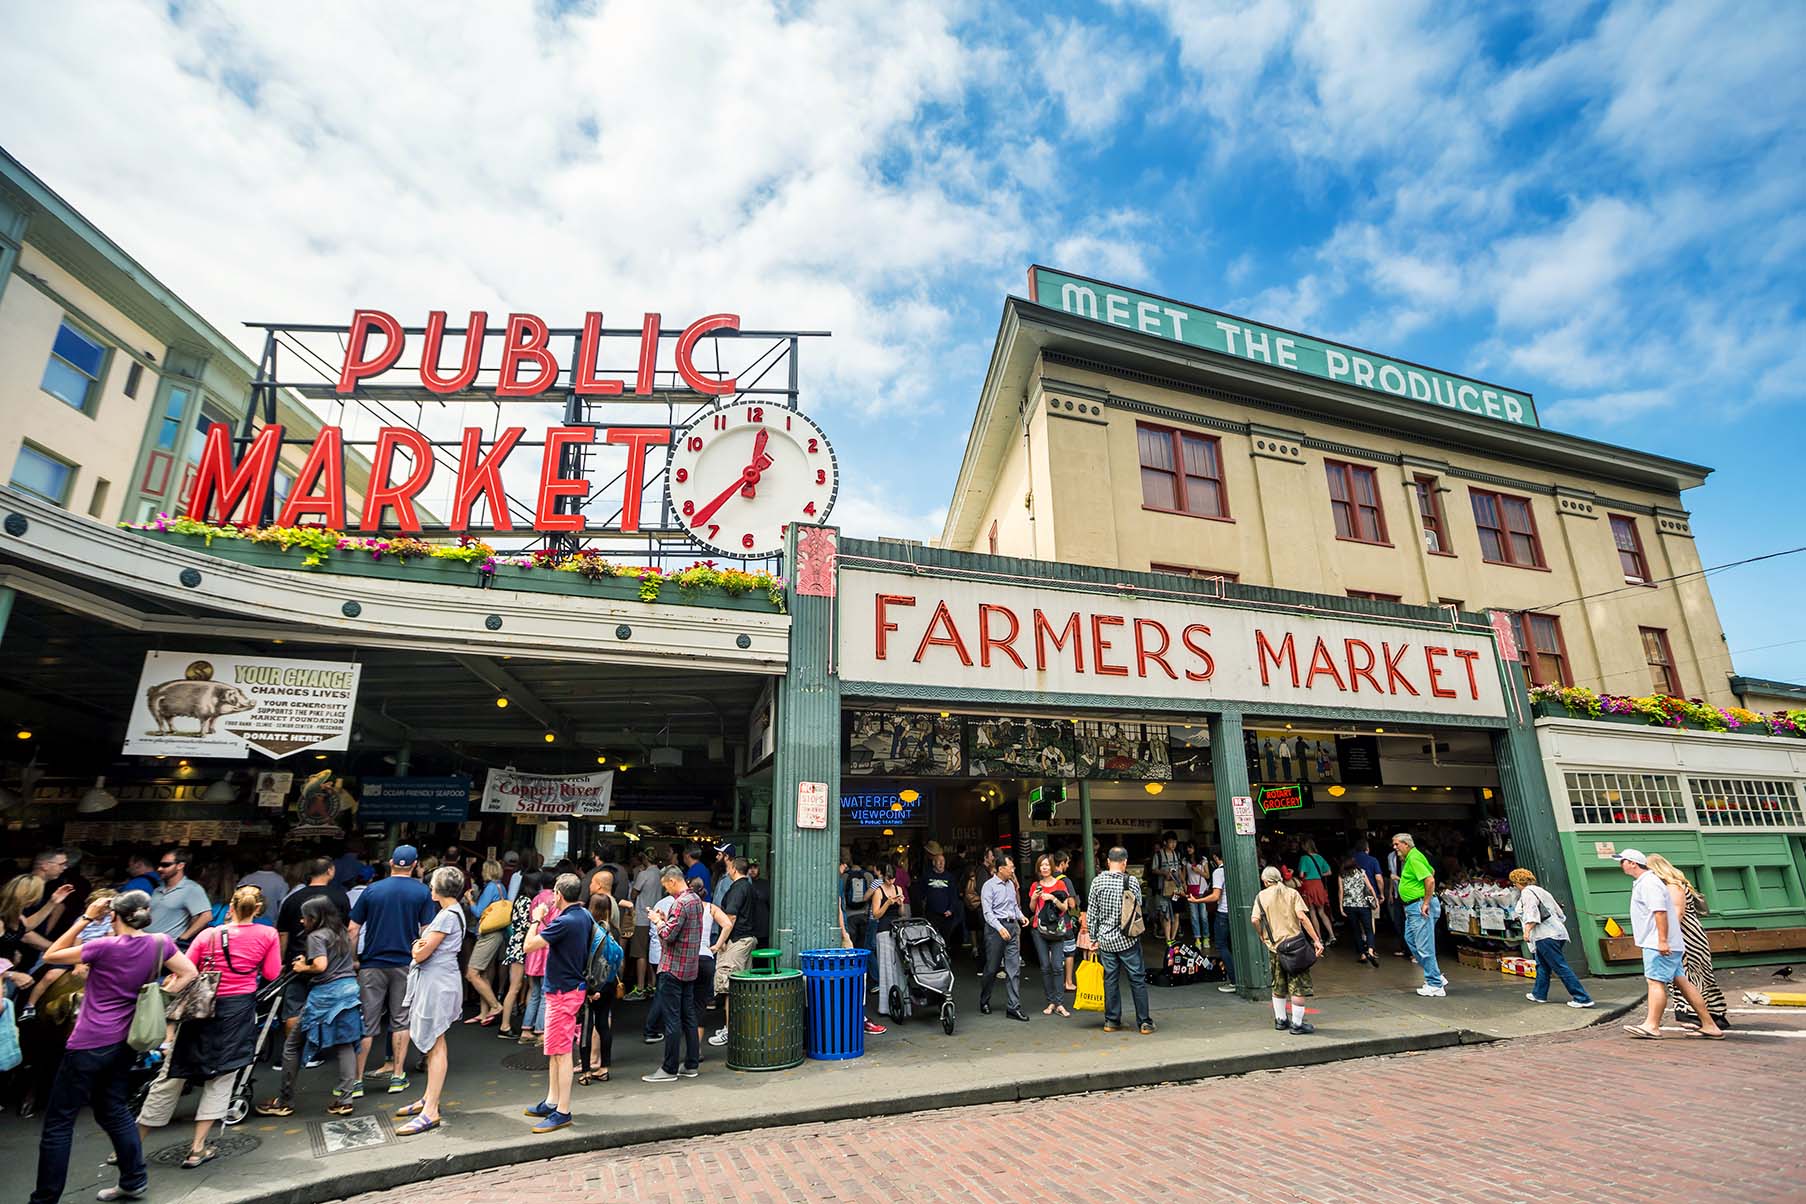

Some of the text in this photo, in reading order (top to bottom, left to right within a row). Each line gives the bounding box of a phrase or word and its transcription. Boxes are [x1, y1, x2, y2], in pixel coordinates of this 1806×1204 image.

[336, 309, 741, 398] PUBLIC
[1061, 282, 1524, 424] MEET THE PRODUCER
[747, 407, 764, 423] 12
[714, 415, 727, 431] 11
[786, 416, 791, 431] 1
[687, 437, 703, 452] 10
[808, 438, 818, 453] 2
[187, 422, 672, 533] MARKET
[676, 468, 688, 483] 9
[816, 469, 826, 485] 3
[683, 500, 695, 516] 8
[803, 501, 816, 516] 4
[708, 524, 720, 539] 7
[742, 533, 754, 549] 6
[875, 592, 1480, 701] FARMERS MARKET
[234, 665, 353, 690] YOUR CHANGE
[251, 686, 351, 699] CHANGES LIVES!
[290, 701, 348, 710] GENEROSITY
[289, 716, 345, 724] FOUNDATION
[243, 733, 323, 742] DONATE HERE!
[500, 782, 601, 800] Copper River
[1266, 789, 1292, 799] ROTARY
[516, 798, 577, 813] Salmon
[1263, 797, 1301, 809] GROCERY
[851, 809, 912, 820] VIEWPOINT
[1080, 992, 1104, 1002] FOREVER
